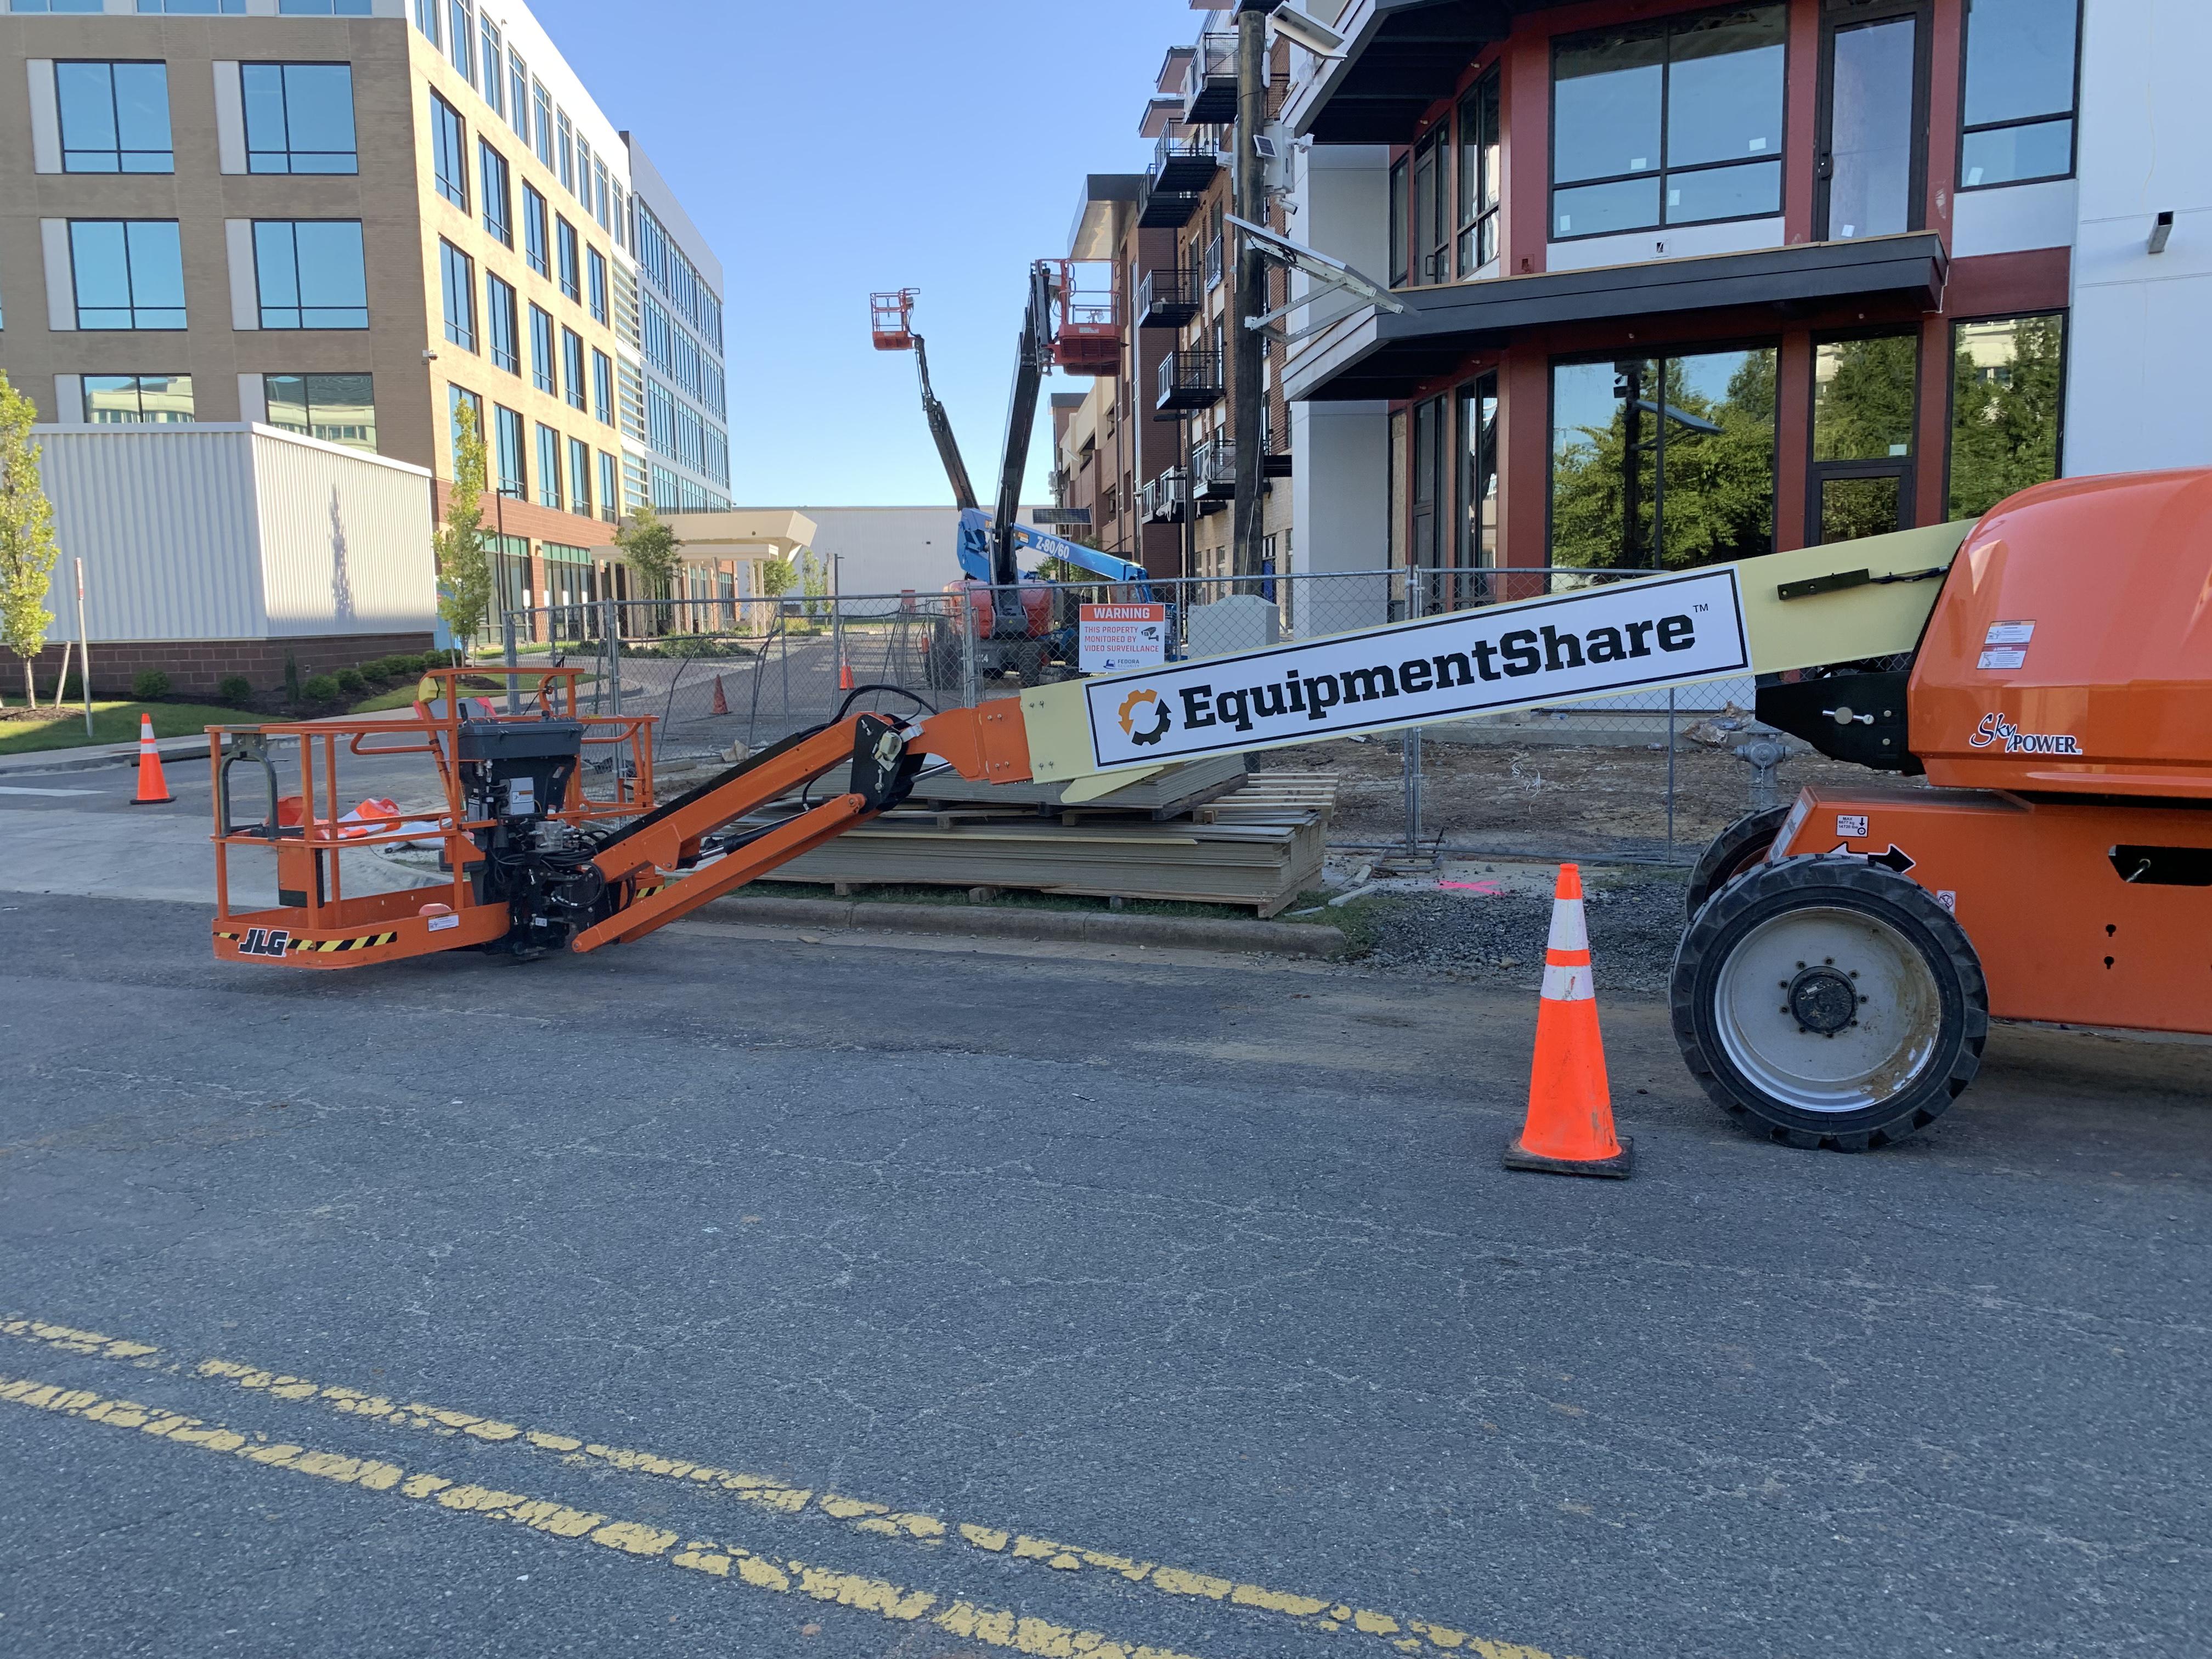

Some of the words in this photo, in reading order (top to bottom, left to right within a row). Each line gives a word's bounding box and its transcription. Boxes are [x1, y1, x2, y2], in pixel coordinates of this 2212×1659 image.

[1036, 535, 1069, 559] Z-80/60
[1093, 607, 1150, 619] WARNING
[1179, 614, 1695, 732] EquipmentShare
[239, 928, 289, 957] JLG
